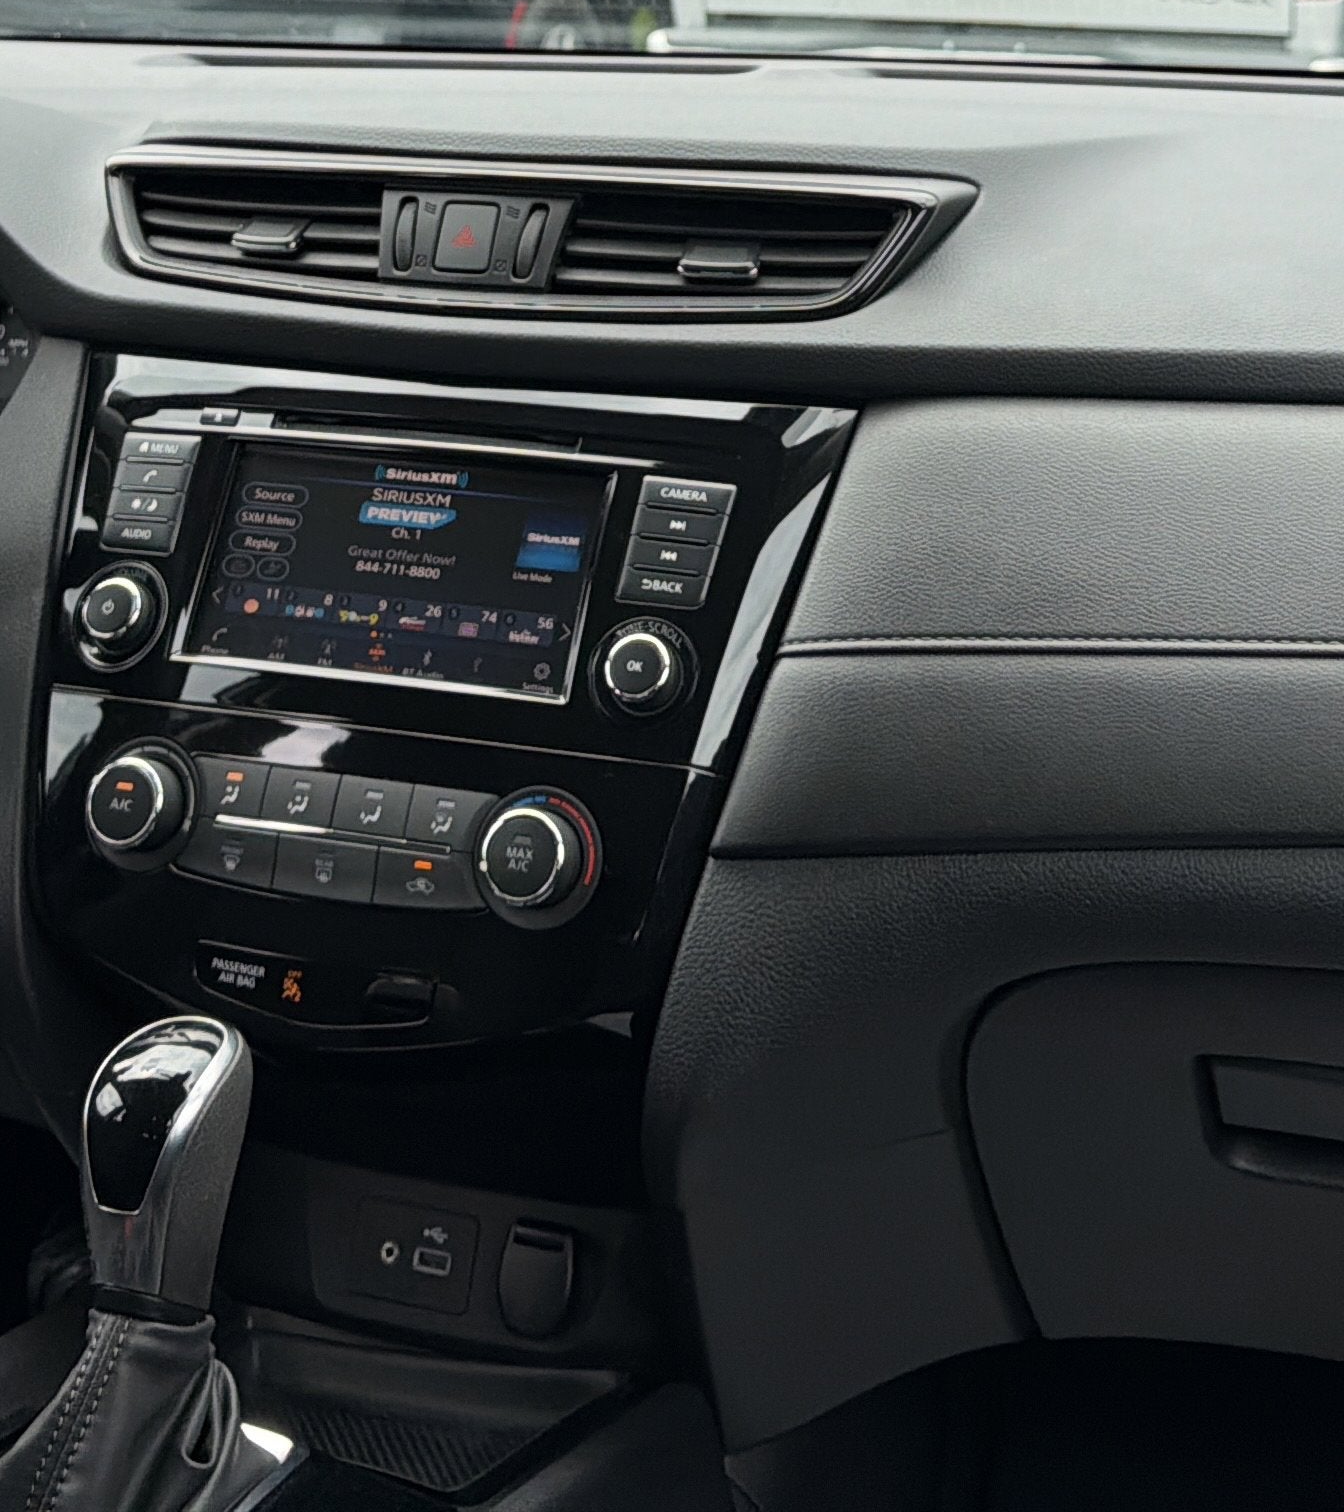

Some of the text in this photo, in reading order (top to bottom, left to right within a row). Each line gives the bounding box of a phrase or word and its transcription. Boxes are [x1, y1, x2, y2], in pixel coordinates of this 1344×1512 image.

[149, 441, 179, 454] MENU
[254, 487, 296, 503] Source
[372, 487, 453, 508] SIRIUSXM
[659, 486, 708, 503] CAMERA
[241, 510, 297, 528] SXM Menu
[367, 506, 449, 526] PREVIEW
[120, 527, 152, 540] AUDIO
[391, 527, 423, 541] Ch. 1
[526, 531, 582, 548] SiriusXM
[243, 535, 280, 552] Replay
[347, 544, 457, 567] Great Offer Now!
[355, 559, 442, 581] 844-711-8800
[530, 572, 554, 585] Mode
[652, 578, 683, 594] BACK
[265, 587, 281, 601] 11
[323, 593, 334, 606] 8
[377, 599, 389, 612] 9
[424, 604, 443, 618] 26
[481, 610, 498, 624] 74
[537, 616, 555, 631] 56
[626, 659, 643, 673] OK
[109, 796, 135, 813] A/C
[505, 845, 534, 861] MAX
[506, 857, 530, 873] A/C
[210, 956, 266, 978] PASSENGER
[217, 970, 256, 989] AIR BAG
